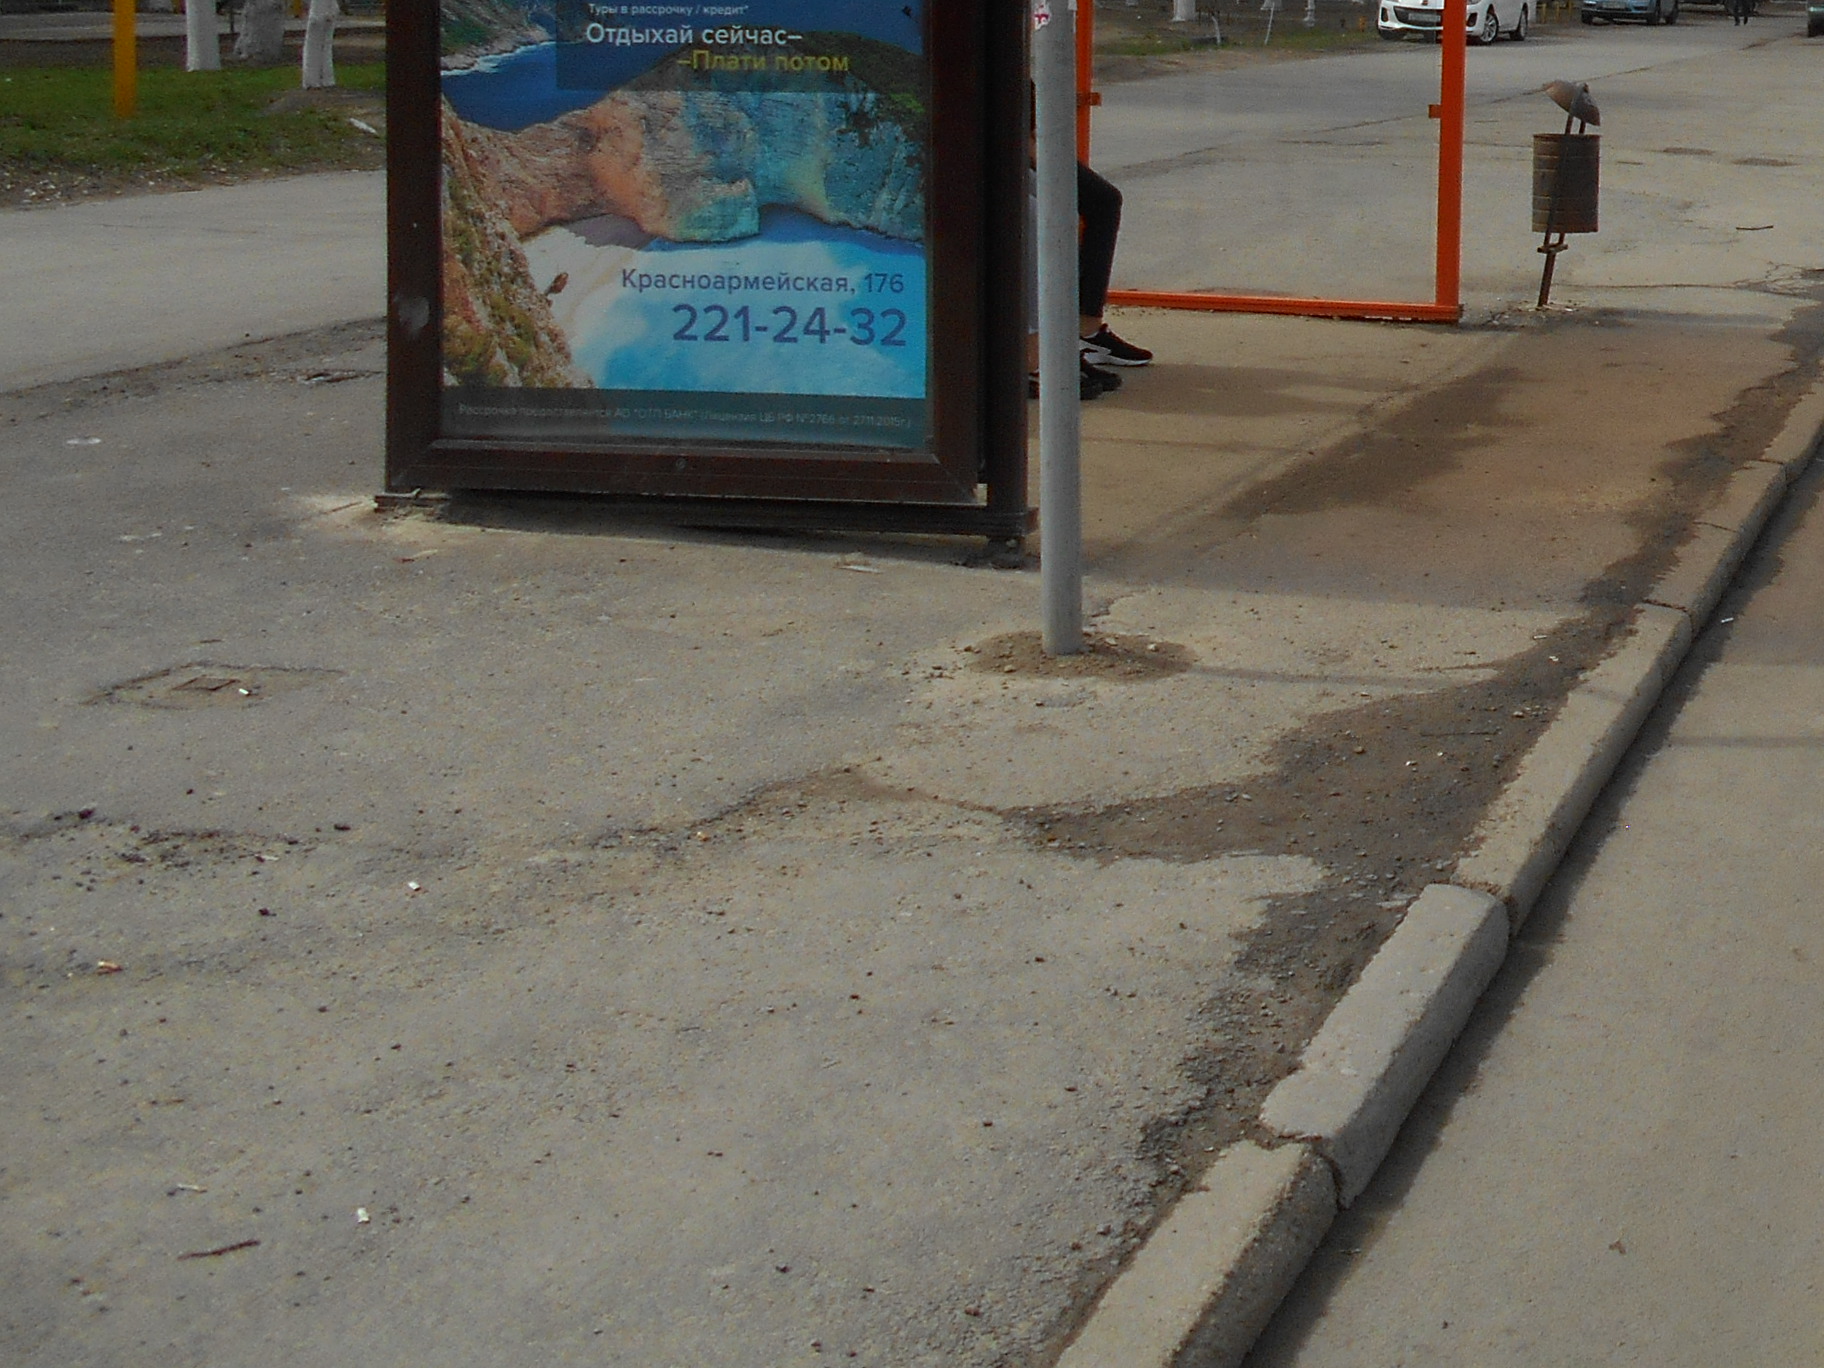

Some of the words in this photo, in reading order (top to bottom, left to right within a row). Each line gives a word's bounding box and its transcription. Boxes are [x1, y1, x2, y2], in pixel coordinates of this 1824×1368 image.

[588, 3, 618, 16] Туры
[621, 6, 628, 15] в
[631, 6, 694, 17] рассрочку
[586, 22, 694, 46] Отдыхай
[774, 55, 849, 72] потом
[621, 268, 857, 295] Красноармейская,
[863, 272, 906, 294] 176
[671, 303, 908, 347] 221-24-32
